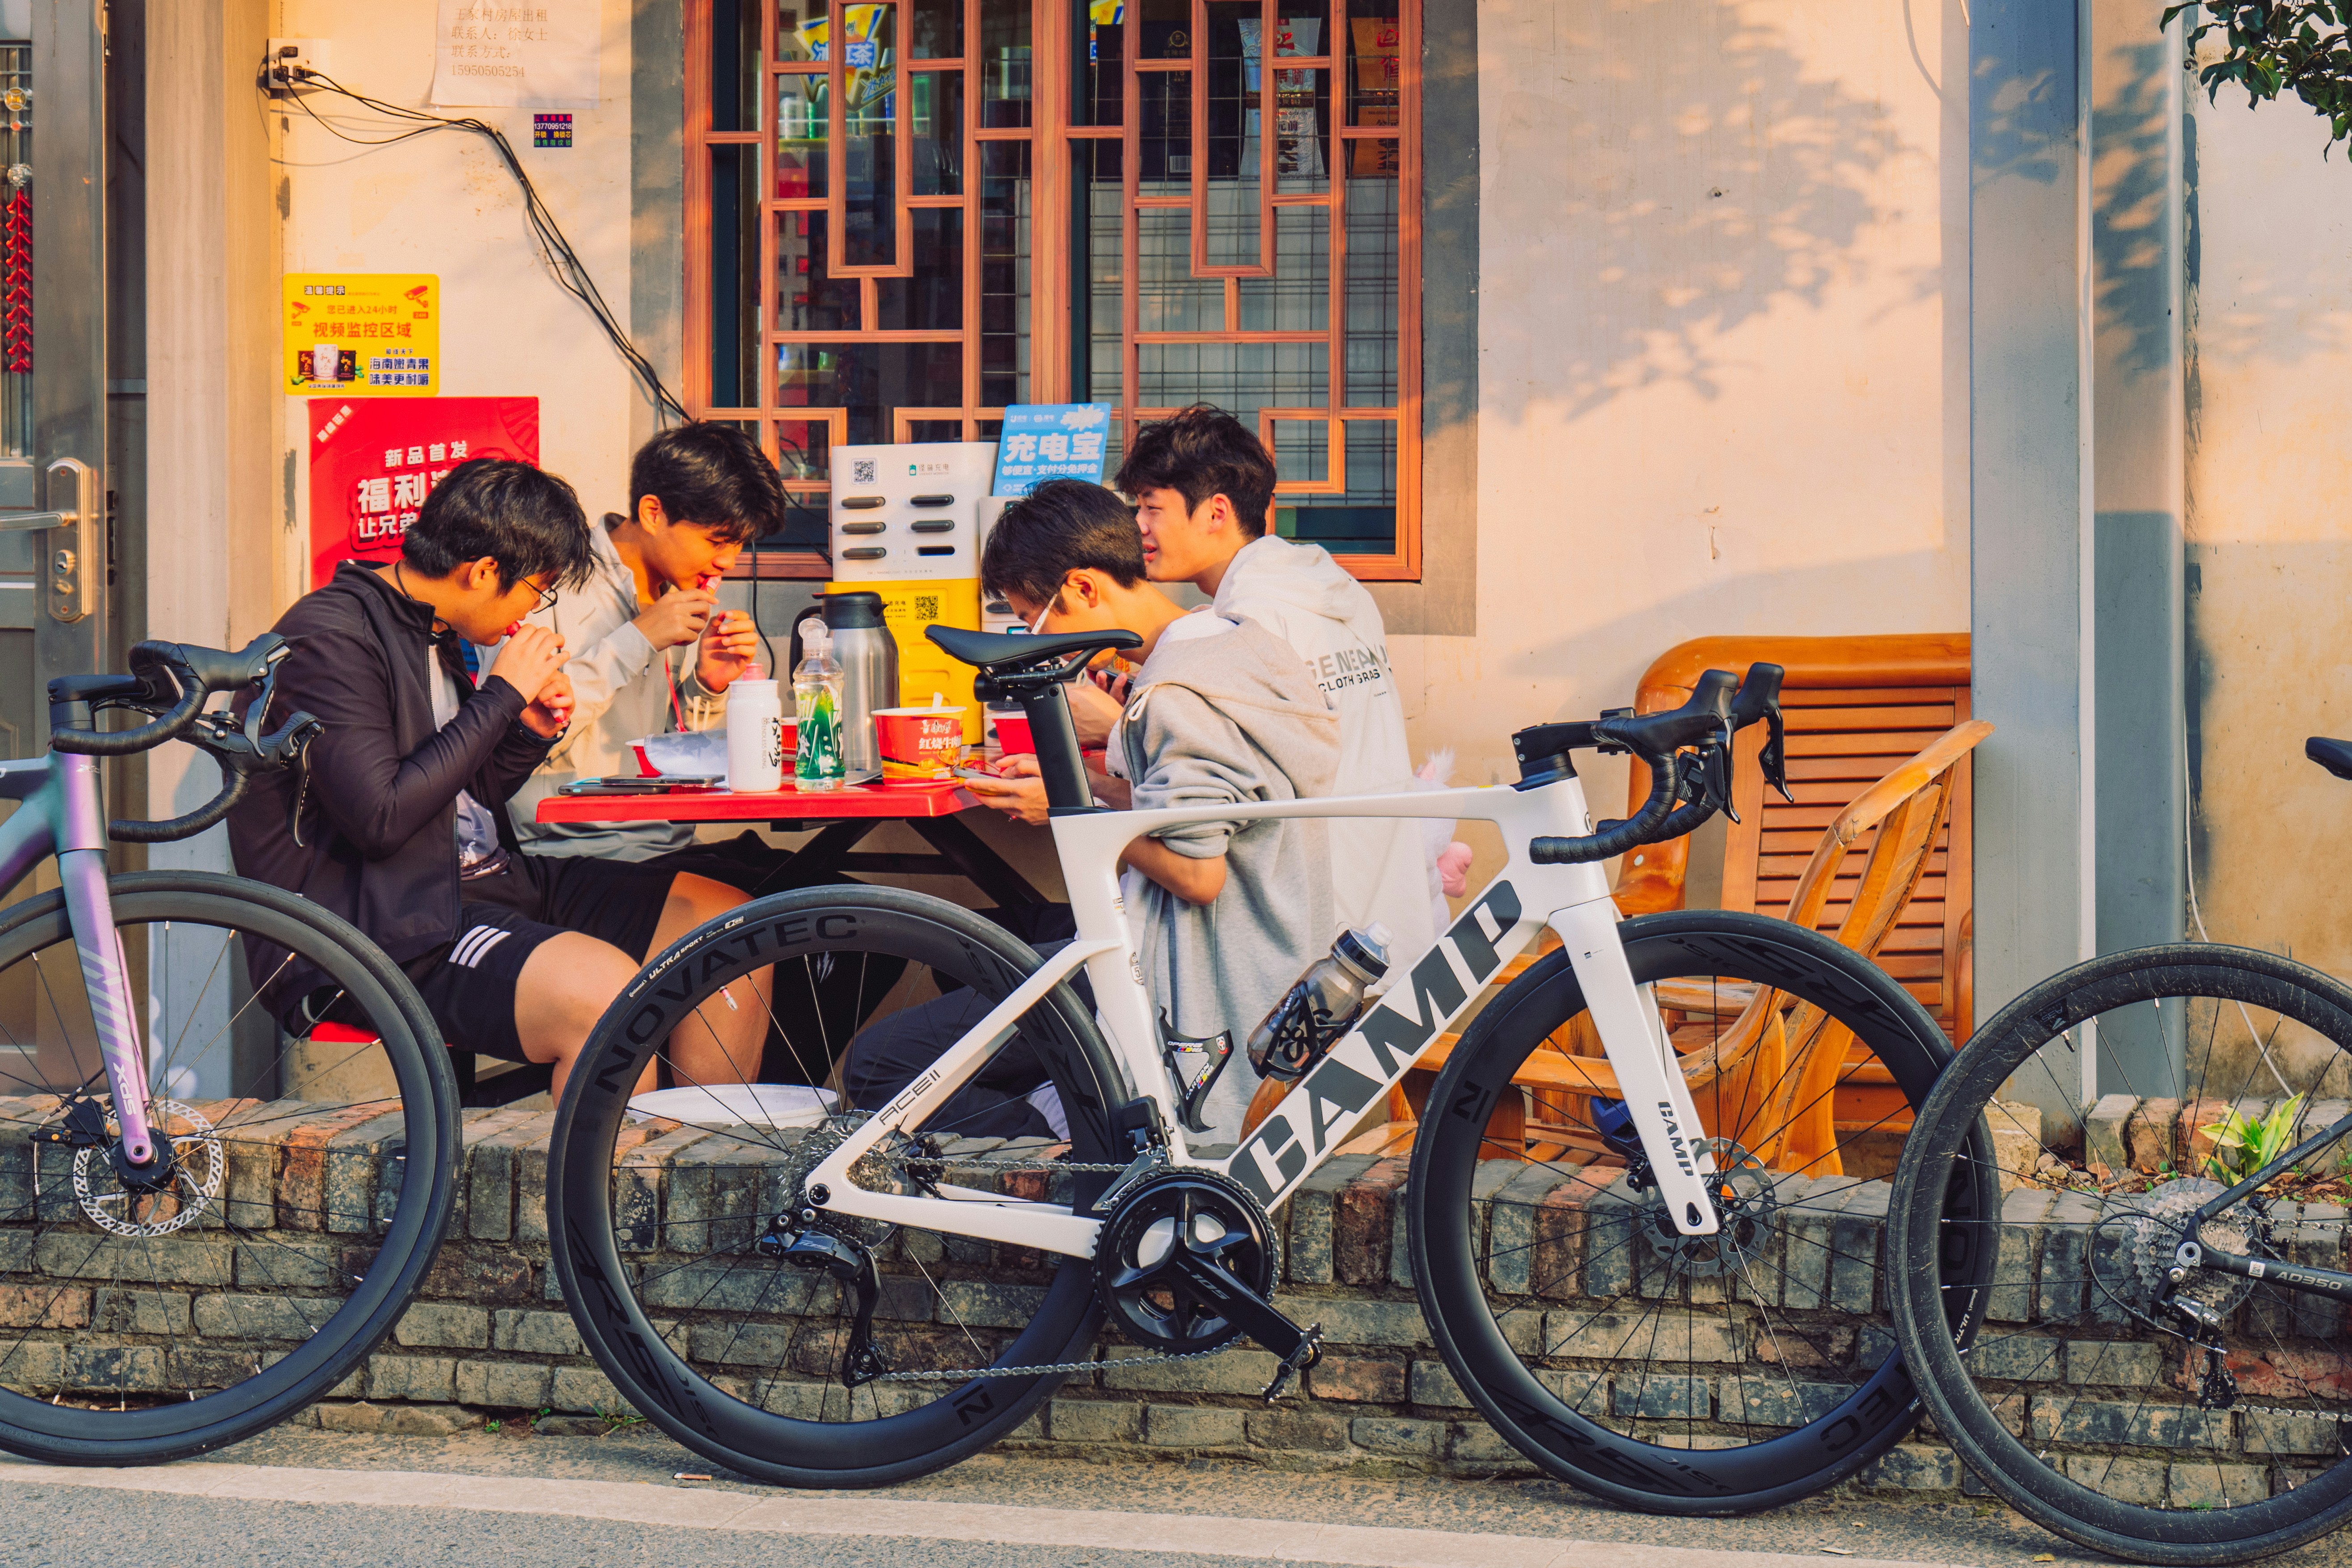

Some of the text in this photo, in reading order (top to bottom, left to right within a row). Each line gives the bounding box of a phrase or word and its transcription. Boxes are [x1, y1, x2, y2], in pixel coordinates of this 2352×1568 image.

[454, 8, 548, 22] 王家村房屋出租
[452, 65, 525, 77] 15950505254
[326, 304, 398, 314] 您已进入24小时
[313, 322, 412, 338] 视频监控区域
[370, 358, 429, 370] 海南嫩青果
[369, 373, 429, 385] 味美更耐嚼
[385, 440, 467, 468] 新品首发
[1004, 431, 1102, 462] 充电宝
[1318, 675, 1354, 693] CLOTH
[649, 951, 681, 980] ULTRA
[680, 935, 703, 954] SPORT
[594, 913, 859, 1095] NOVATEC
[1229, 879, 1522, 1213] CAMP
[112, 1063, 137, 1116] SPX
[1658, 1101, 1694, 1176] CAMP
[1191, 1273, 1231, 1299] 105
[2275, 1271, 2343, 1291] AD350
[1954, 1313, 1970, 1344] ULTR
